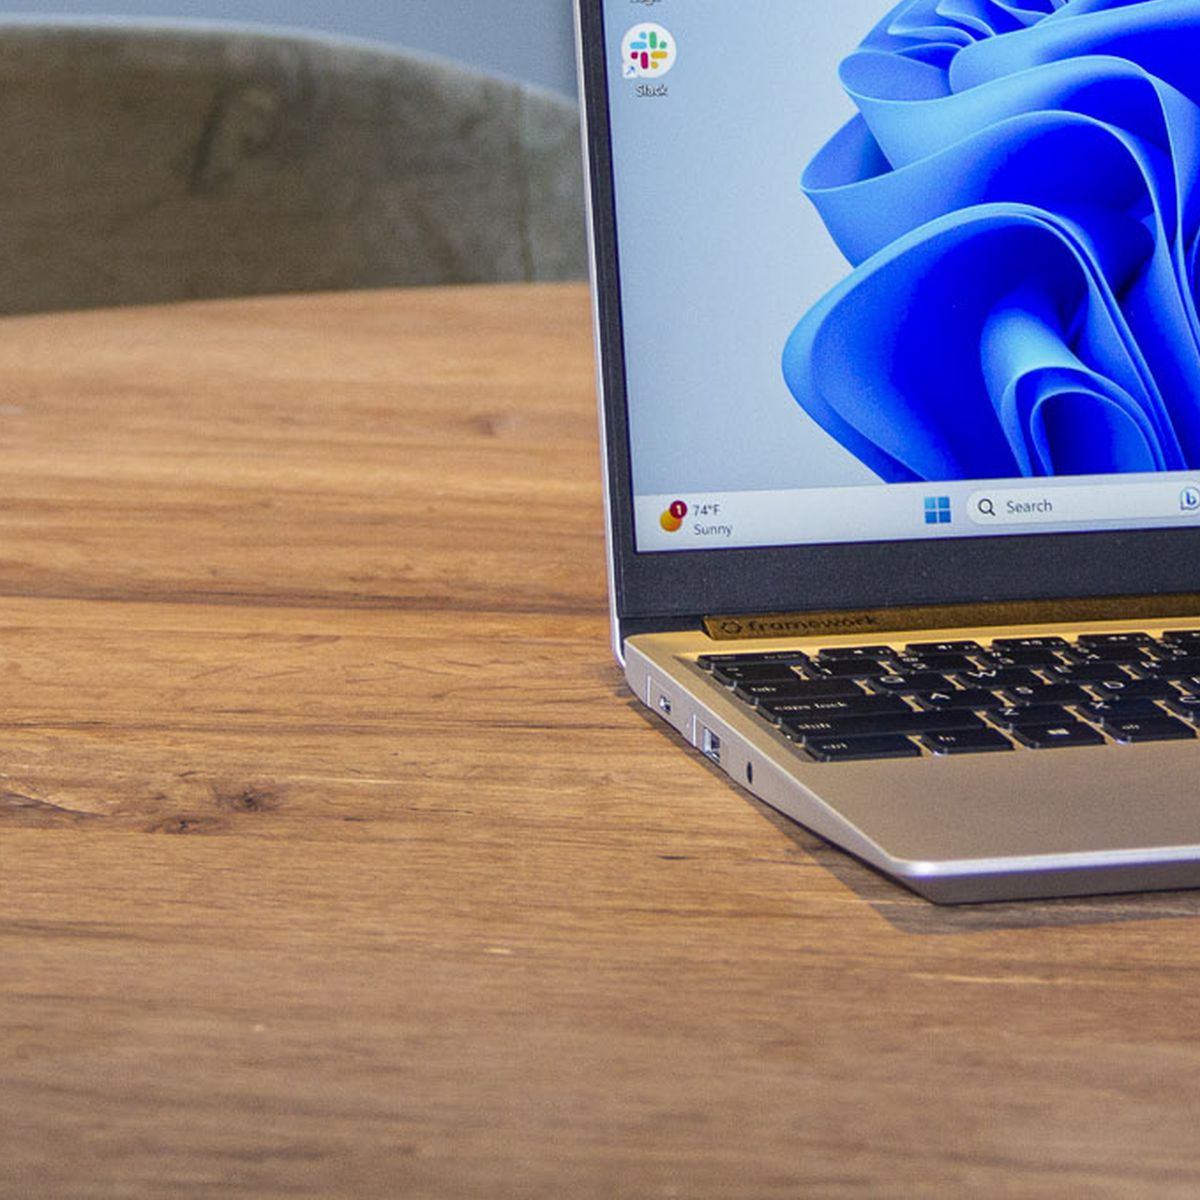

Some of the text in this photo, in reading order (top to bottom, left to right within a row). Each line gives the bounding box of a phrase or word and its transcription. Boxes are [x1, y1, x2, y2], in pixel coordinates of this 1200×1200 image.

[635, 84, 668, 97] Slack
[692, 504, 720, 516] 74°F
[1006, 498, 1053, 514] Search
[694, 523, 732, 537] Sunny
[749, 616, 876, 631] framework
